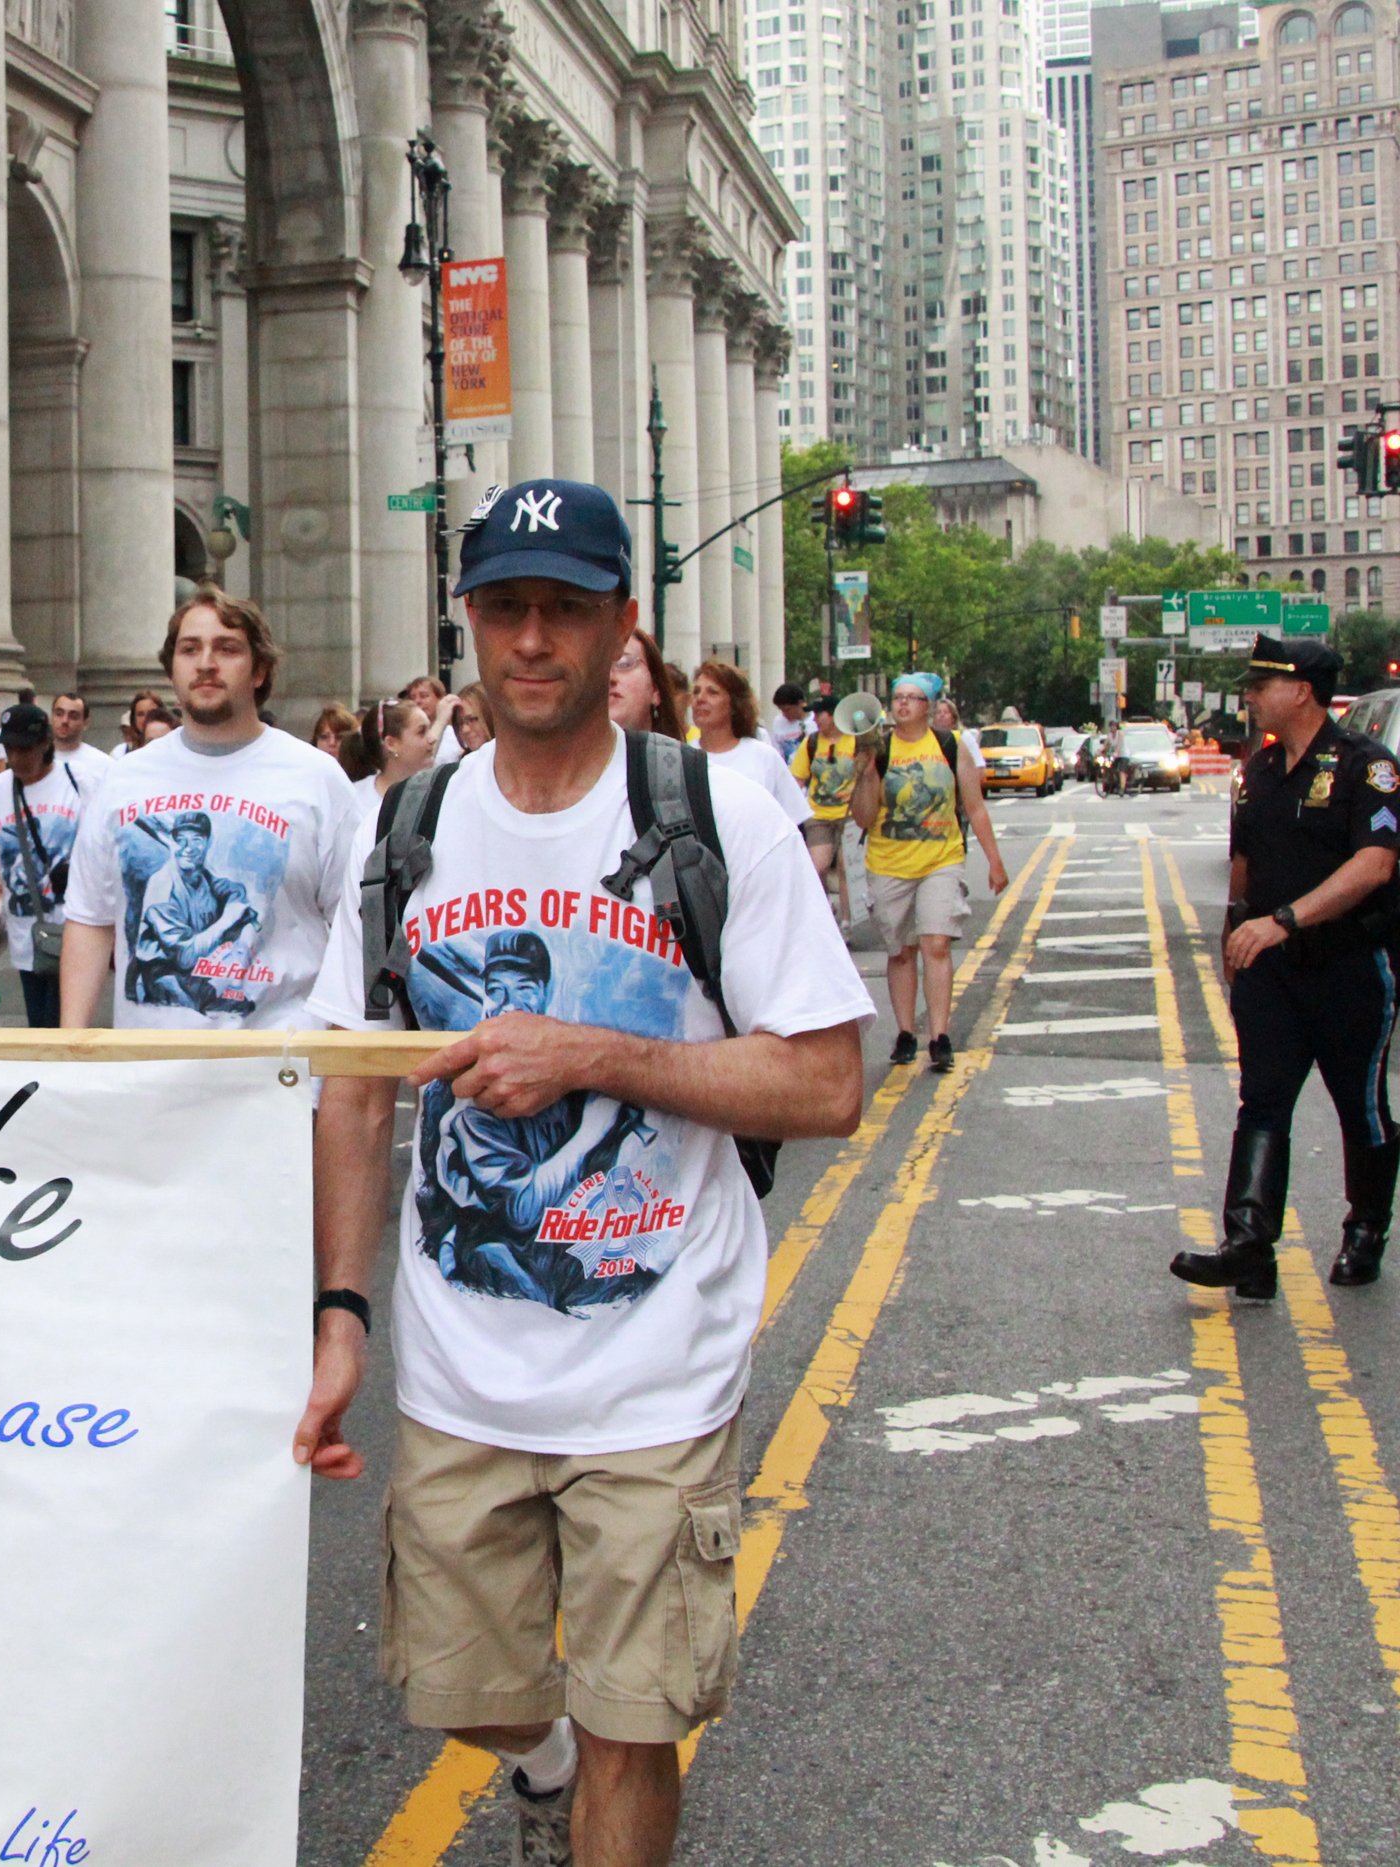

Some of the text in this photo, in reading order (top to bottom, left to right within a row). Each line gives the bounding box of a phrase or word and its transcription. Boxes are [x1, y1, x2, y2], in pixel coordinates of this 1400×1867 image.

[450, 264, 498, 287] NYC
[449, 298, 473, 313] THE
[450, 308, 504, 326] OFFICIAL
[450, 322, 490, 338] STORE
[450, 335, 495, 352] OF THE
[451, 348, 498, 365] CITY OF
[451, 364, 481, 378] NEW
[452, 377, 487, 390] YORK
[390, 497, 425, 509] CENTRE
[1203, 593, 1249, 602] Brooklyn
[119, 793, 290, 839] 15 YEARS OF FIGHT
[425, 888, 527, 943] YEARS
[540, 888, 581, 929] OF
[194, 959, 227, 978] Ride
[248, 965, 274, 983] Life
[568, 1170, 605, 1209] CURE
[539, 1198, 686, 1241] Ride For Life
[594, 1257, 637, 1279] 2012
[0, 1807, 90, 1867] Life
